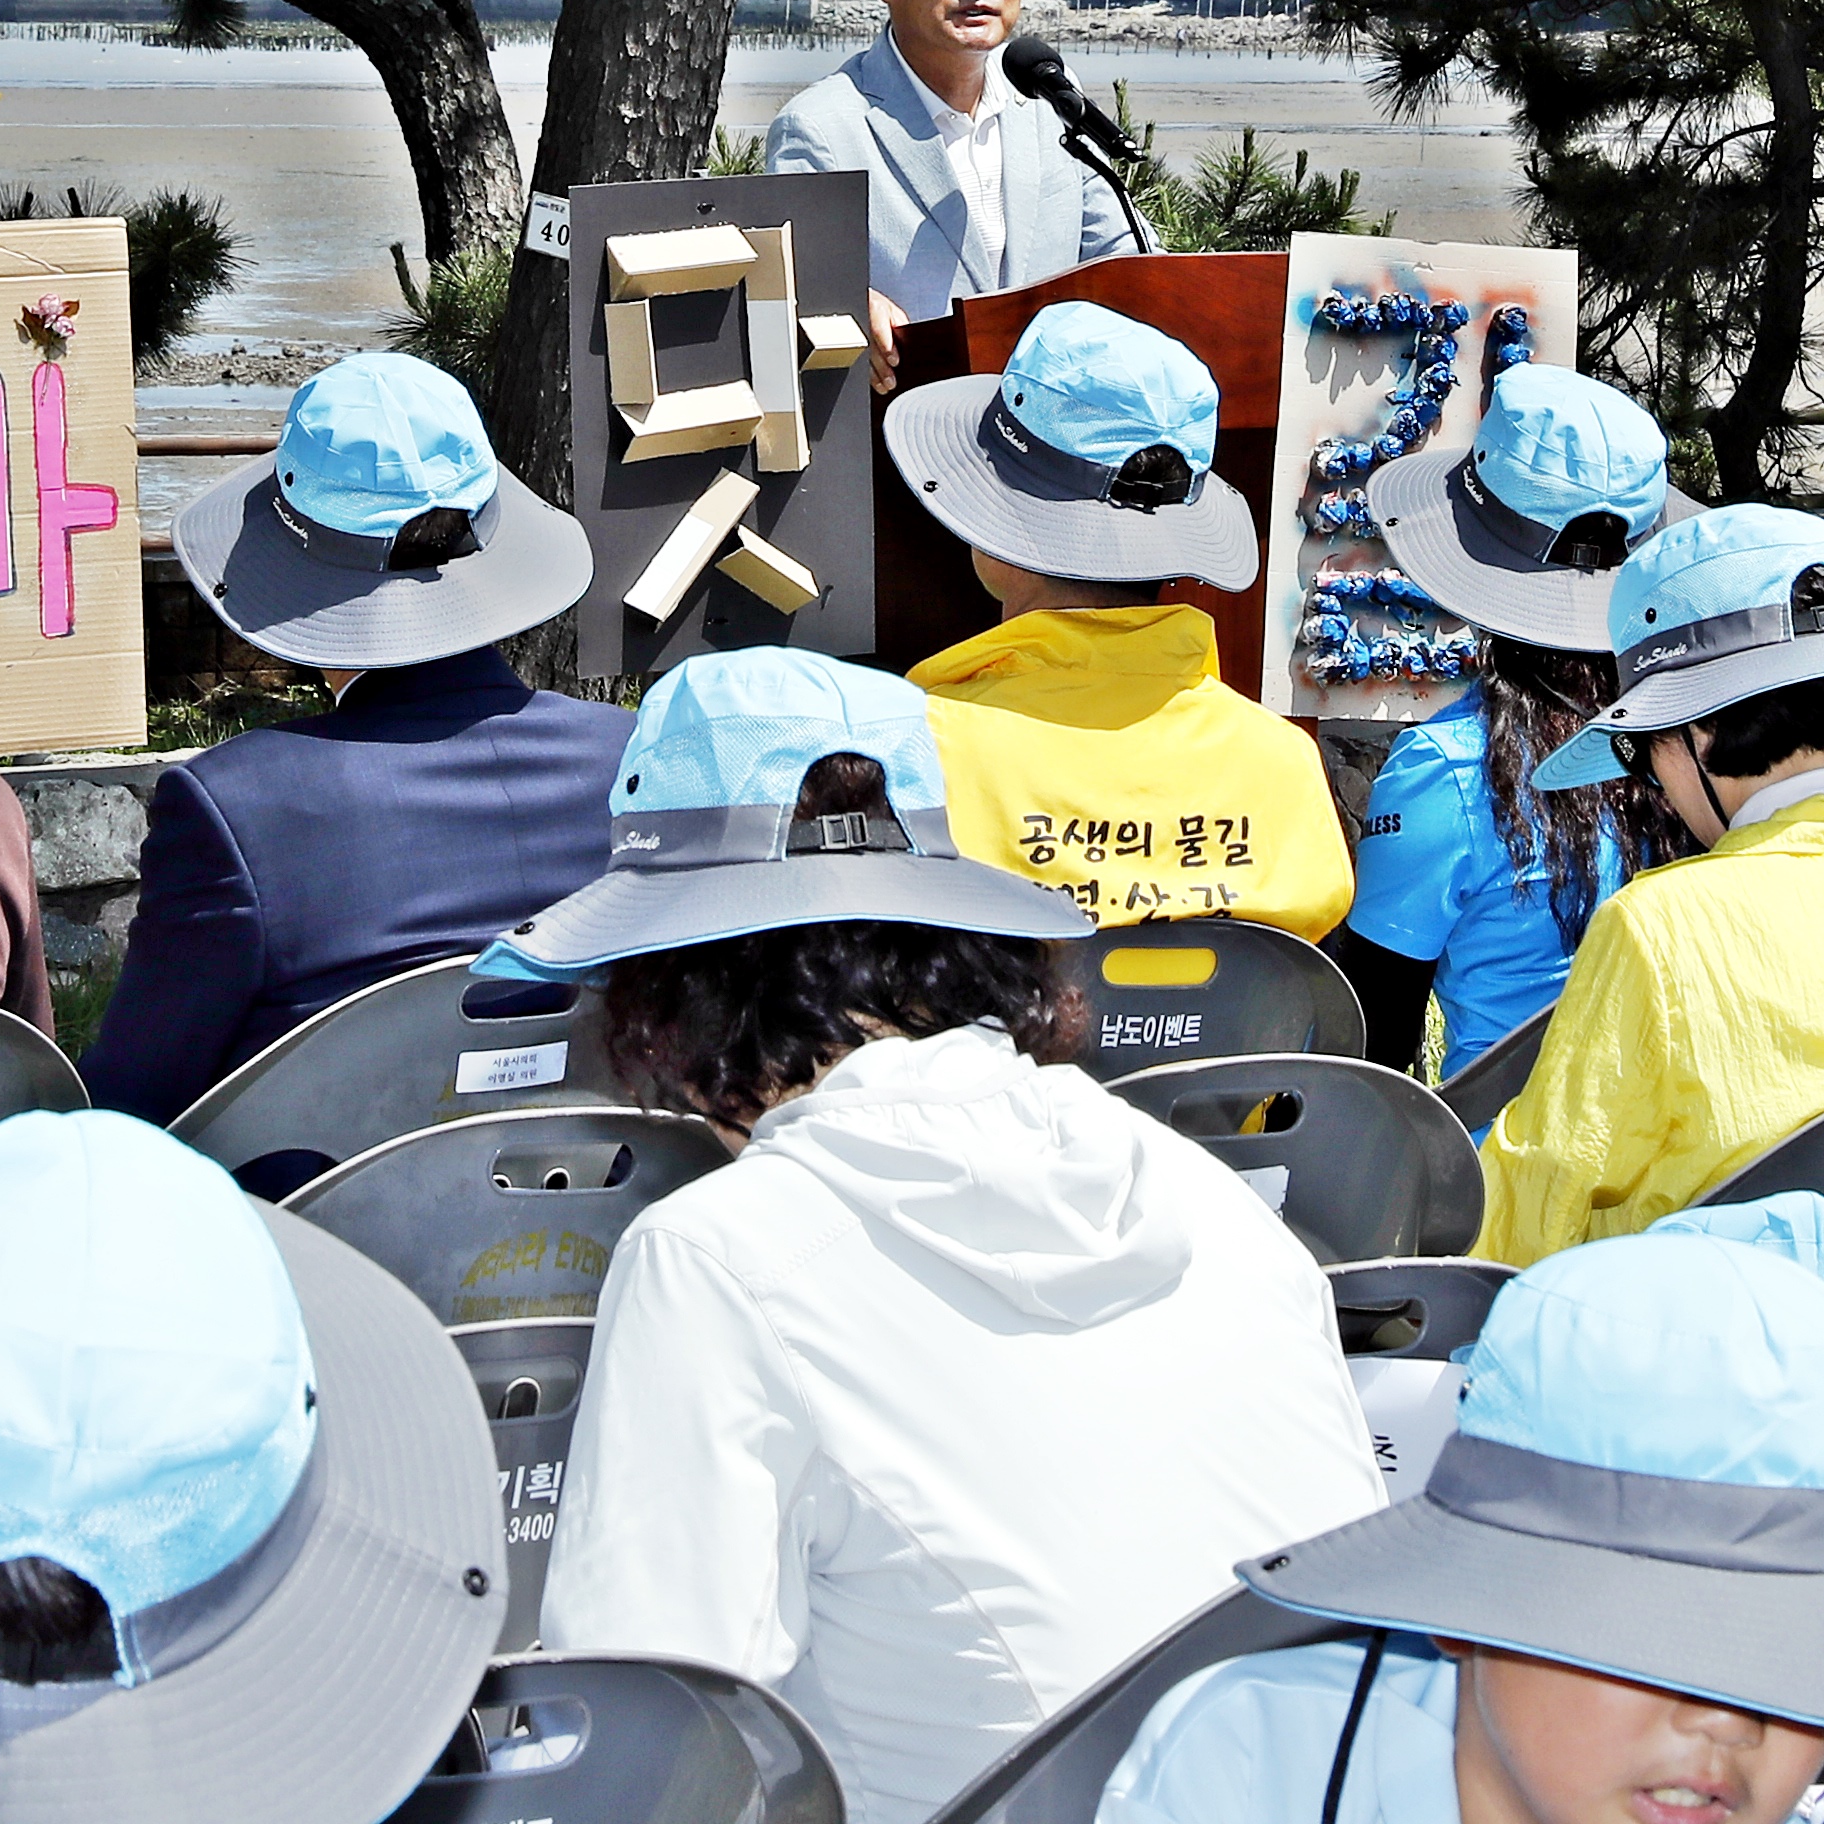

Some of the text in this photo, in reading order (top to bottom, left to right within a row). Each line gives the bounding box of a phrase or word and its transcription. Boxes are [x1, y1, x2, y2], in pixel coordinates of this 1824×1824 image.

[540, 220, 570, 246] 40
[1019, 814, 1254, 868] 공생의 물길
[1099, 1013, 1203, 1050] 남도이벤트
